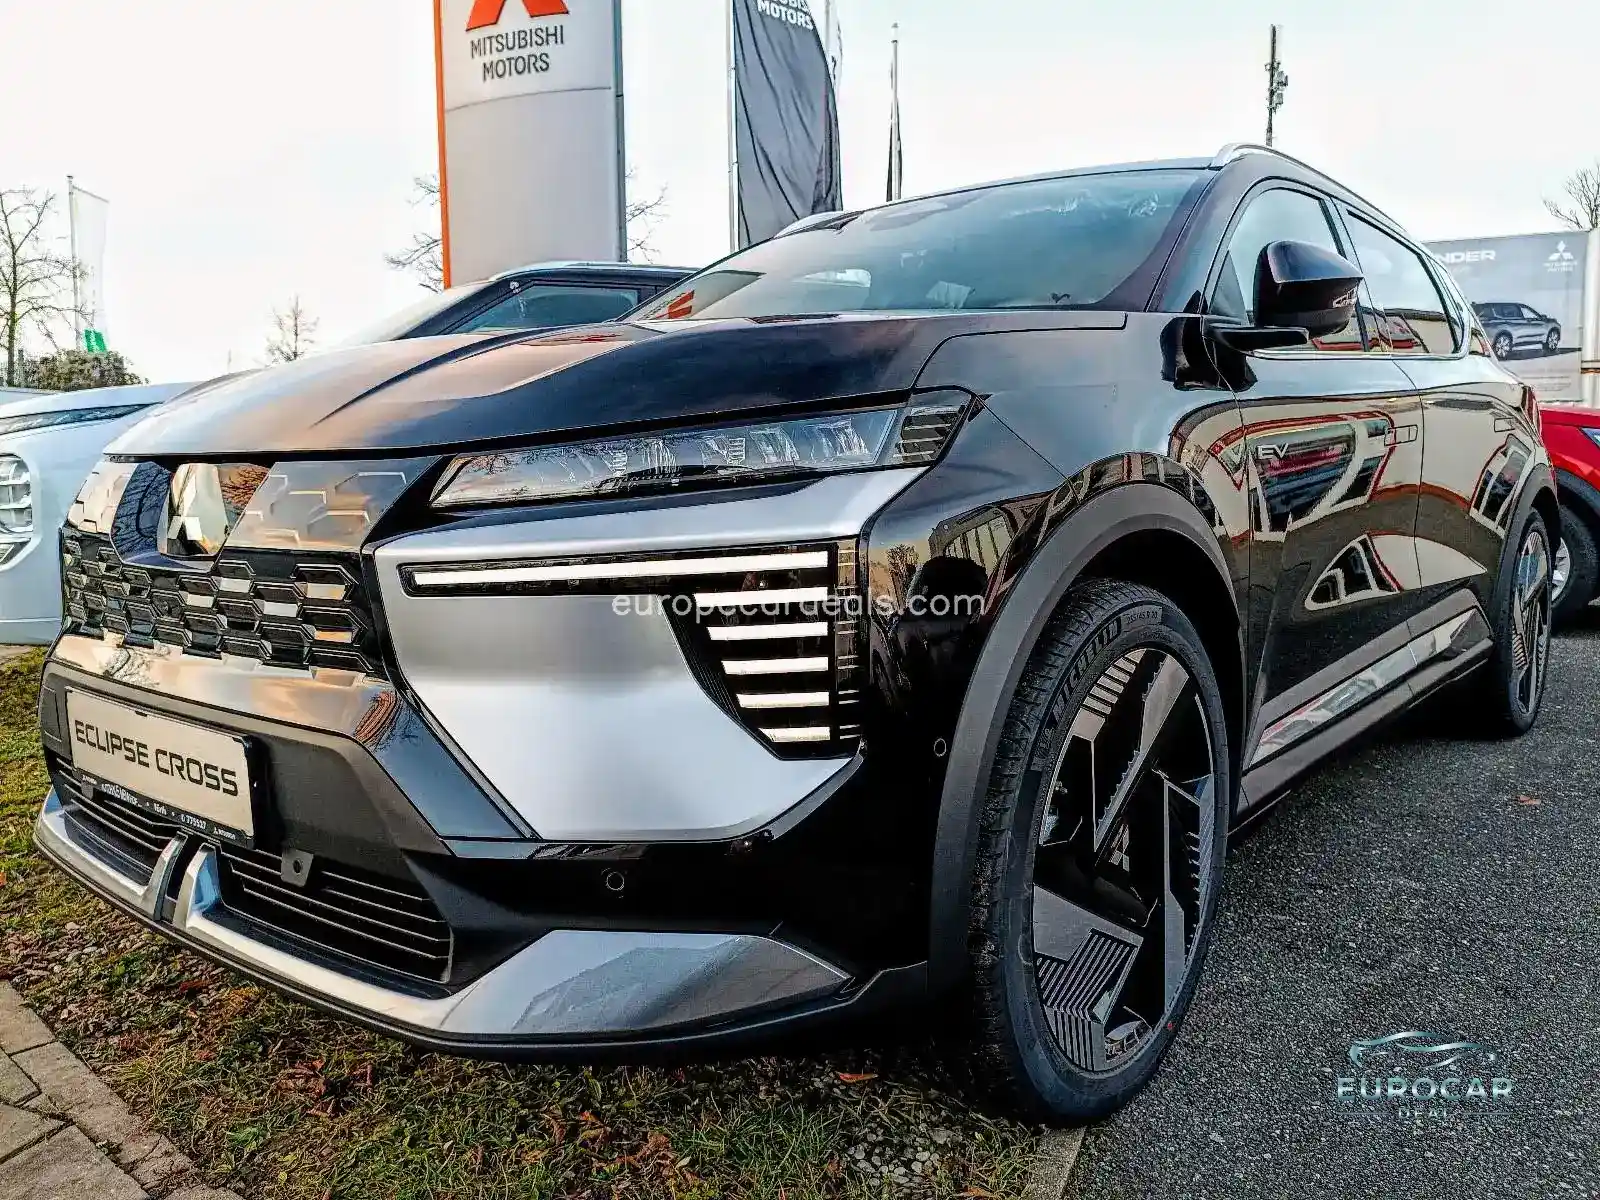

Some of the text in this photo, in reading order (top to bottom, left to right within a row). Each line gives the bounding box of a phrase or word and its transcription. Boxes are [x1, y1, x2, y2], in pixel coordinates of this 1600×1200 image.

[757, 0, 813, 30] MOTORS
[470, 25, 564, 59] MITSUBISHI
[483, 52, 550, 83] MOTORS
[1257, 443, 1289, 460] EV
[74, 720, 149, 768] ECLIPSE
[155, 748, 239, 797] CROSS
